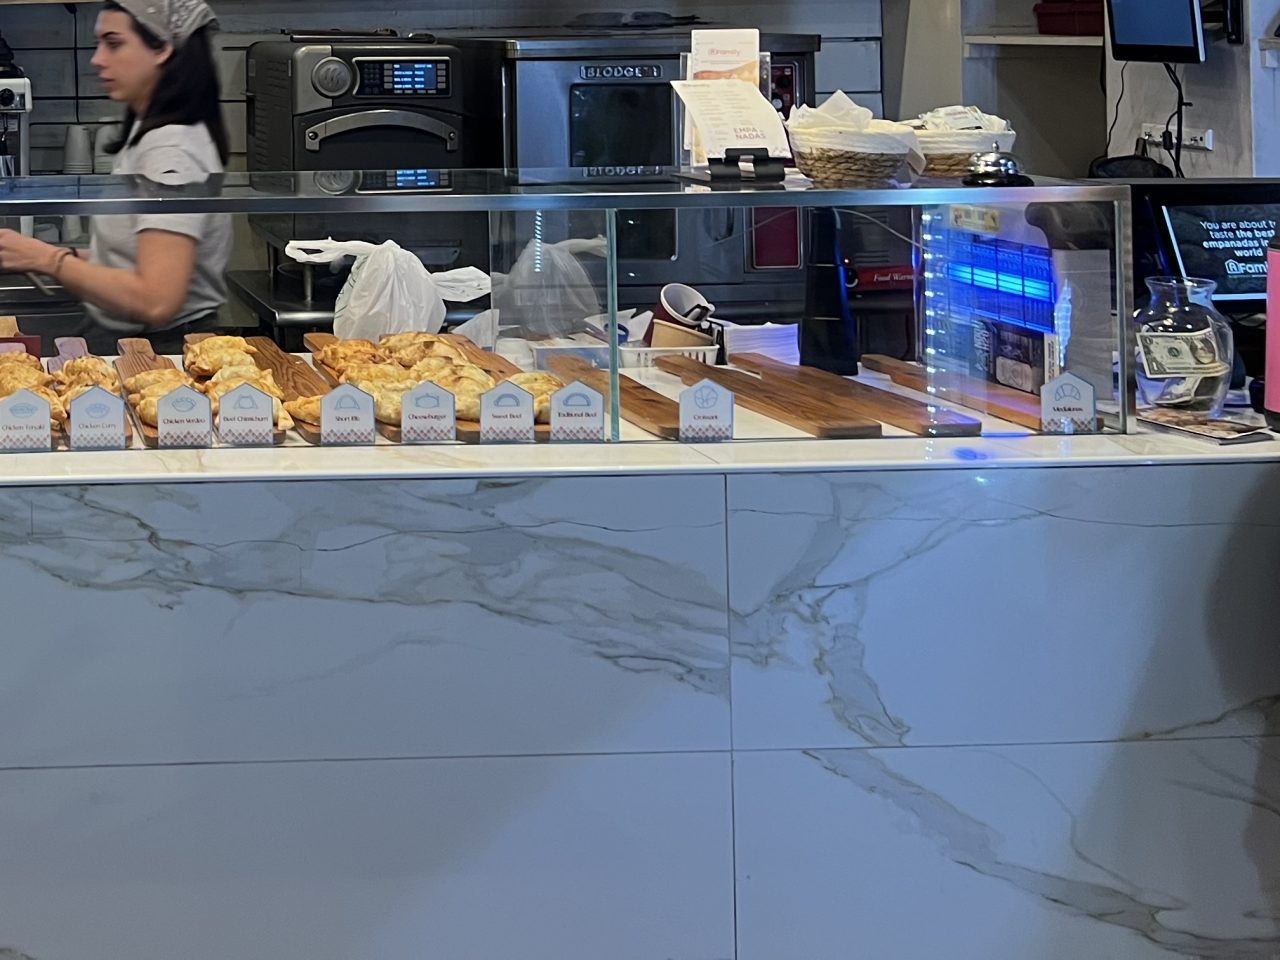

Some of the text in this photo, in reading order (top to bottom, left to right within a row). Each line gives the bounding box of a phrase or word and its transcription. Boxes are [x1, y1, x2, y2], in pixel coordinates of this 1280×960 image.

[735, 132, 767, 140] NADAS
[1200, 220, 1220, 230] You
[1221, 221, 1237, 230] are
[1239, 220, 1268, 229] about
[1209, 230, 1234, 240] taste
[1235, 229, 1253, 239] the
[1202, 239, 1260, 250] empanadas
[1233, 247, 1264, 258] world
[407, 413, 447, 421] Cheeseburger
